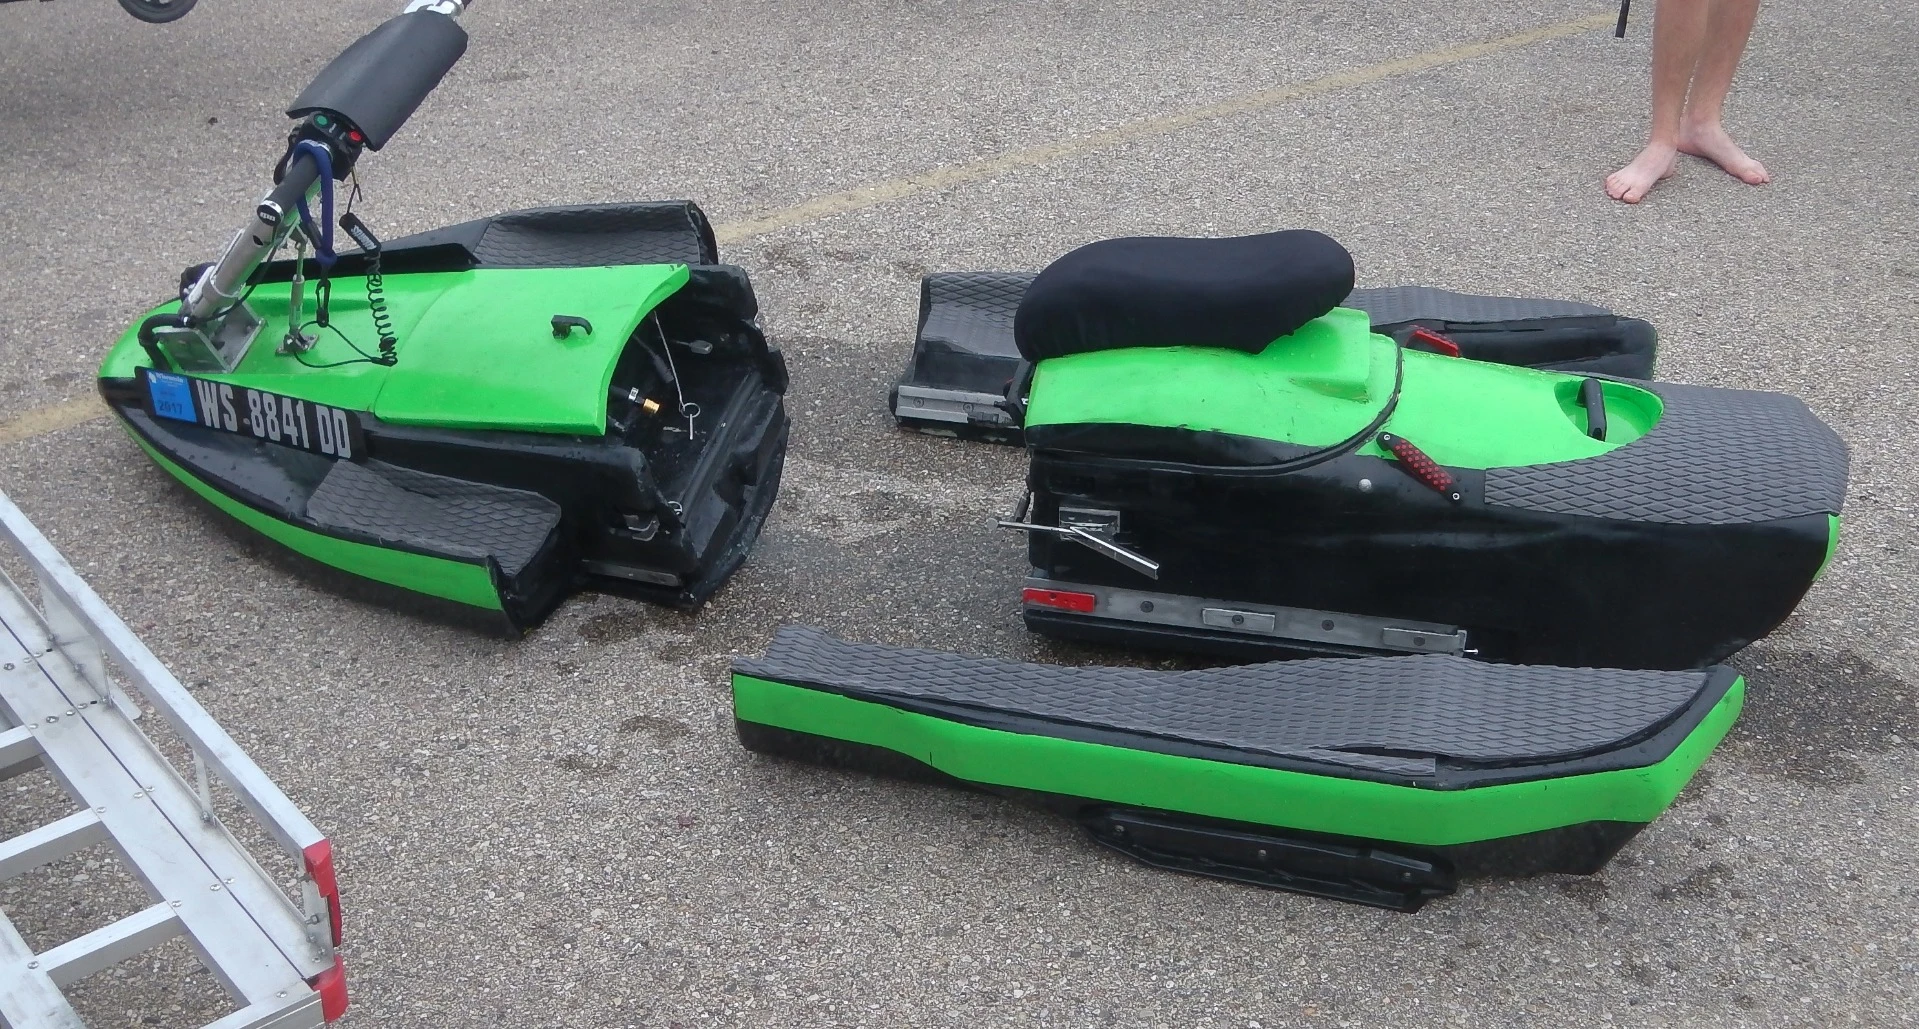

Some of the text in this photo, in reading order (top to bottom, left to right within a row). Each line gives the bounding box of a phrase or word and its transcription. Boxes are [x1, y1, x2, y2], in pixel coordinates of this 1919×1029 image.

[158, 399, 183, 415] 2017
[196, 379, 352, 459] WS 8841 DD
